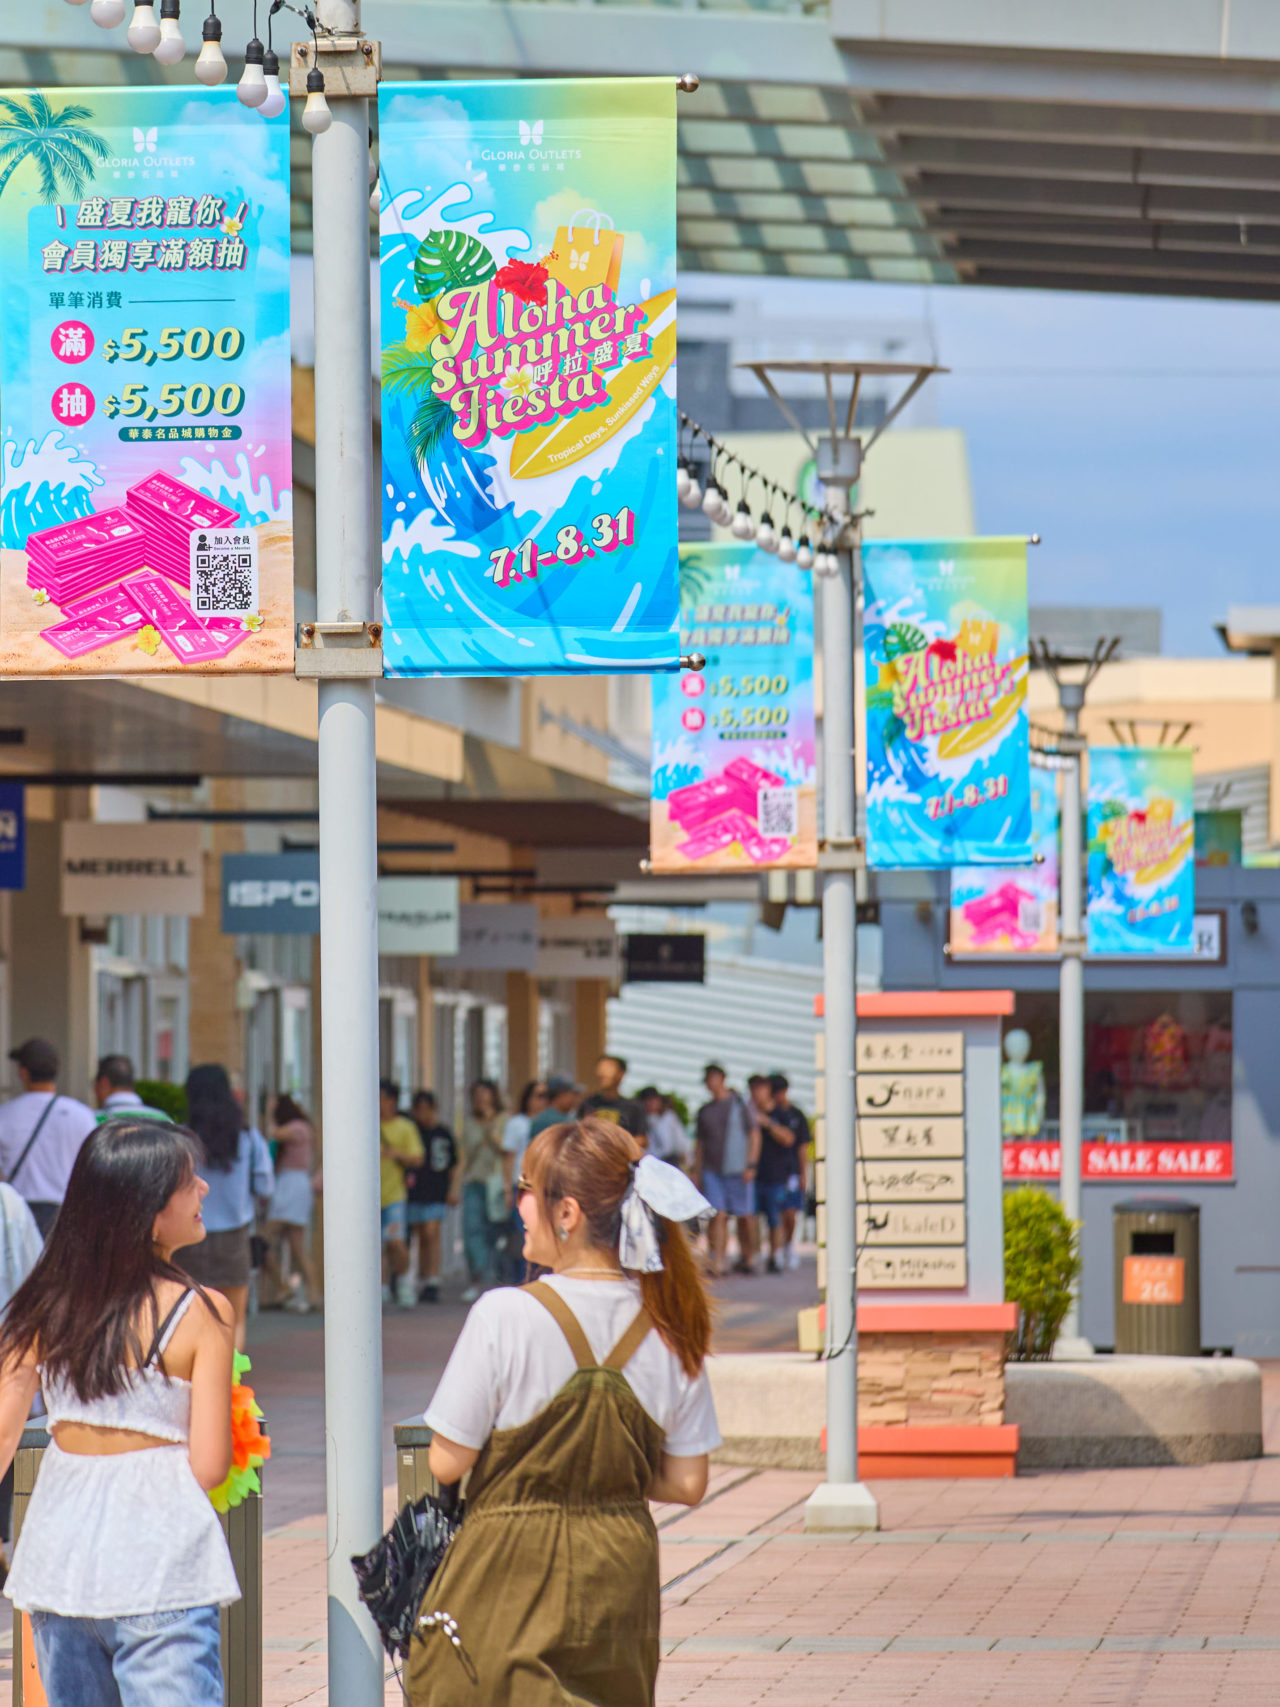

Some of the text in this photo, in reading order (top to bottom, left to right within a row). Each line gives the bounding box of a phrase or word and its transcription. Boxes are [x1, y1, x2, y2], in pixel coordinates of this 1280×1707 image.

[96, 156, 195, 168] GLORIA OUTLETS
[481, 149, 582, 161] GLORIA OUTLETS
[76, 195, 224, 228] 盛夏我寵你
[42, 239, 247, 272] 會員獨享滿額抽
[49, 291, 123, 309] 單筆消費
[430, 278, 612, 360] Aloha
[59, 327, 86, 357] 滿
[101, 327, 244, 364] $5,500
[430, 304, 636, 394] Summer
[533, 331, 645, 383] 呼拉盛夏
[59, 388, 87, 417] 抽
[102, 383, 245, 420] $5,500
[450, 371, 600, 440] Fiesta
[547, 365, 660, 463] Tropical Days, Sunkissed Ways
[128, 427, 233, 440] 華泰名品城購物金
[214, 535, 250, 545] 加入會員
[65, 858, 193, 876] MERRELL
[1019, 1148, 1061, 1173] SAL
[1087, 1148, 1153, 1173] SALE
[1157, 1148, 1223, 1173] SALE
